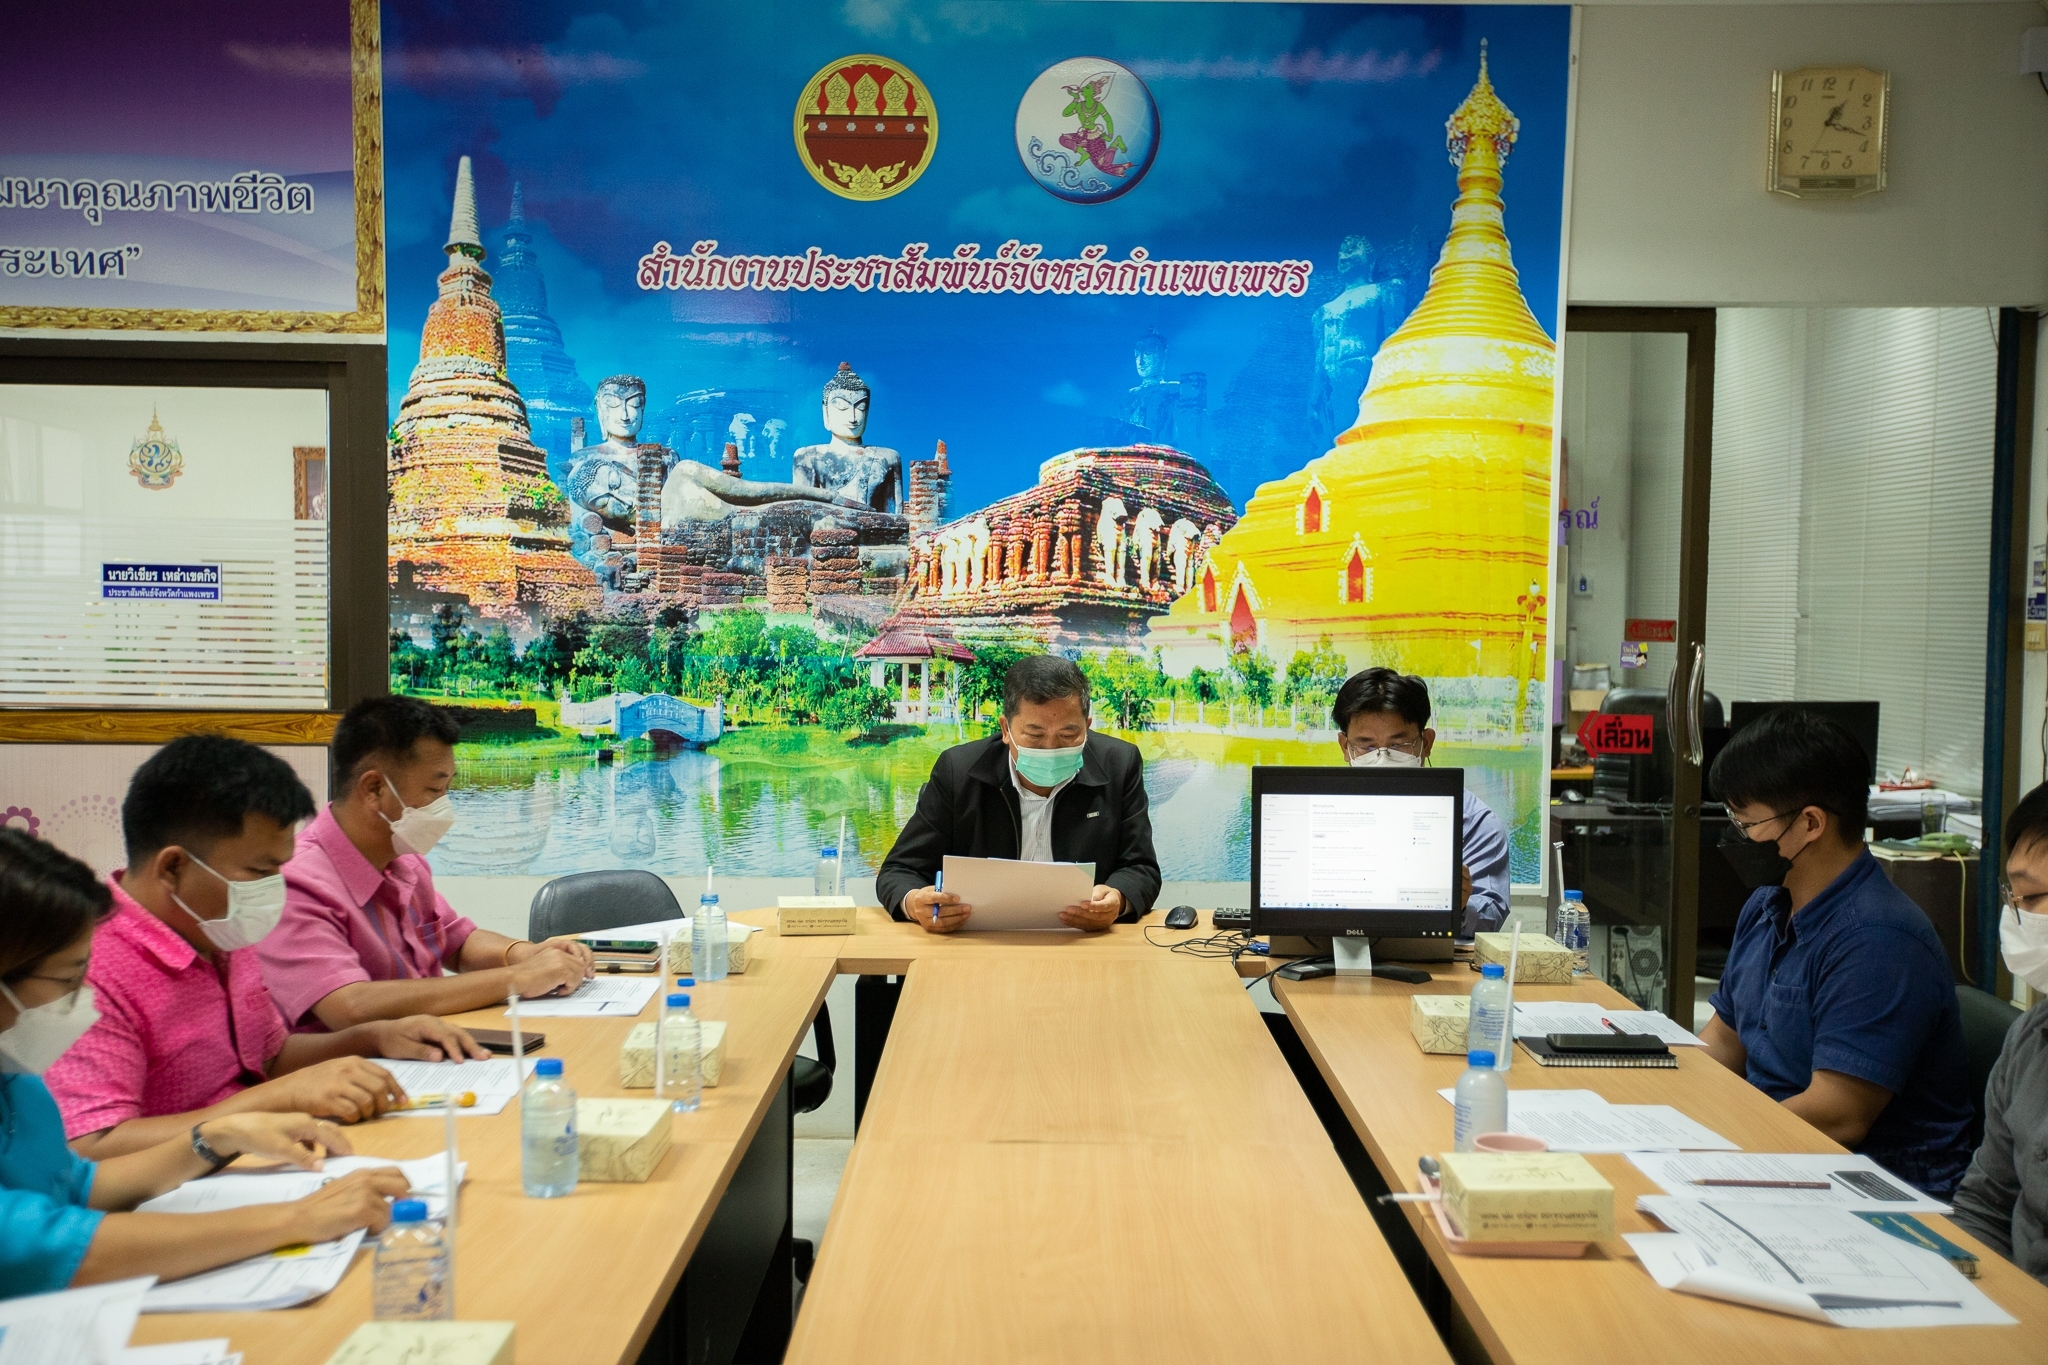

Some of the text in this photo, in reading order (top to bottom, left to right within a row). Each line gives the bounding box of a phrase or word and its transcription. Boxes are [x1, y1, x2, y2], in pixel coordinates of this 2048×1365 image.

[1861, 93, 1872, 108] 2
[1783, 117, 1793, 131] 9
[1861, 116, 1872, 131] 3
[1783, 140, 1793, 154] 8
[1800, 155, 1810, 170] 7
[1820, 156, 1830, 170] 6
[1842, 155, 1853, 170] 5
[638, 240, 1311, 295] สำนักงานประชาสัมพันธ์จังหวัดกำแพงเพชร
[108, 566, 159, 582] นายวิเชียร
[1597, 716, 1650, 748] เลื่อน
